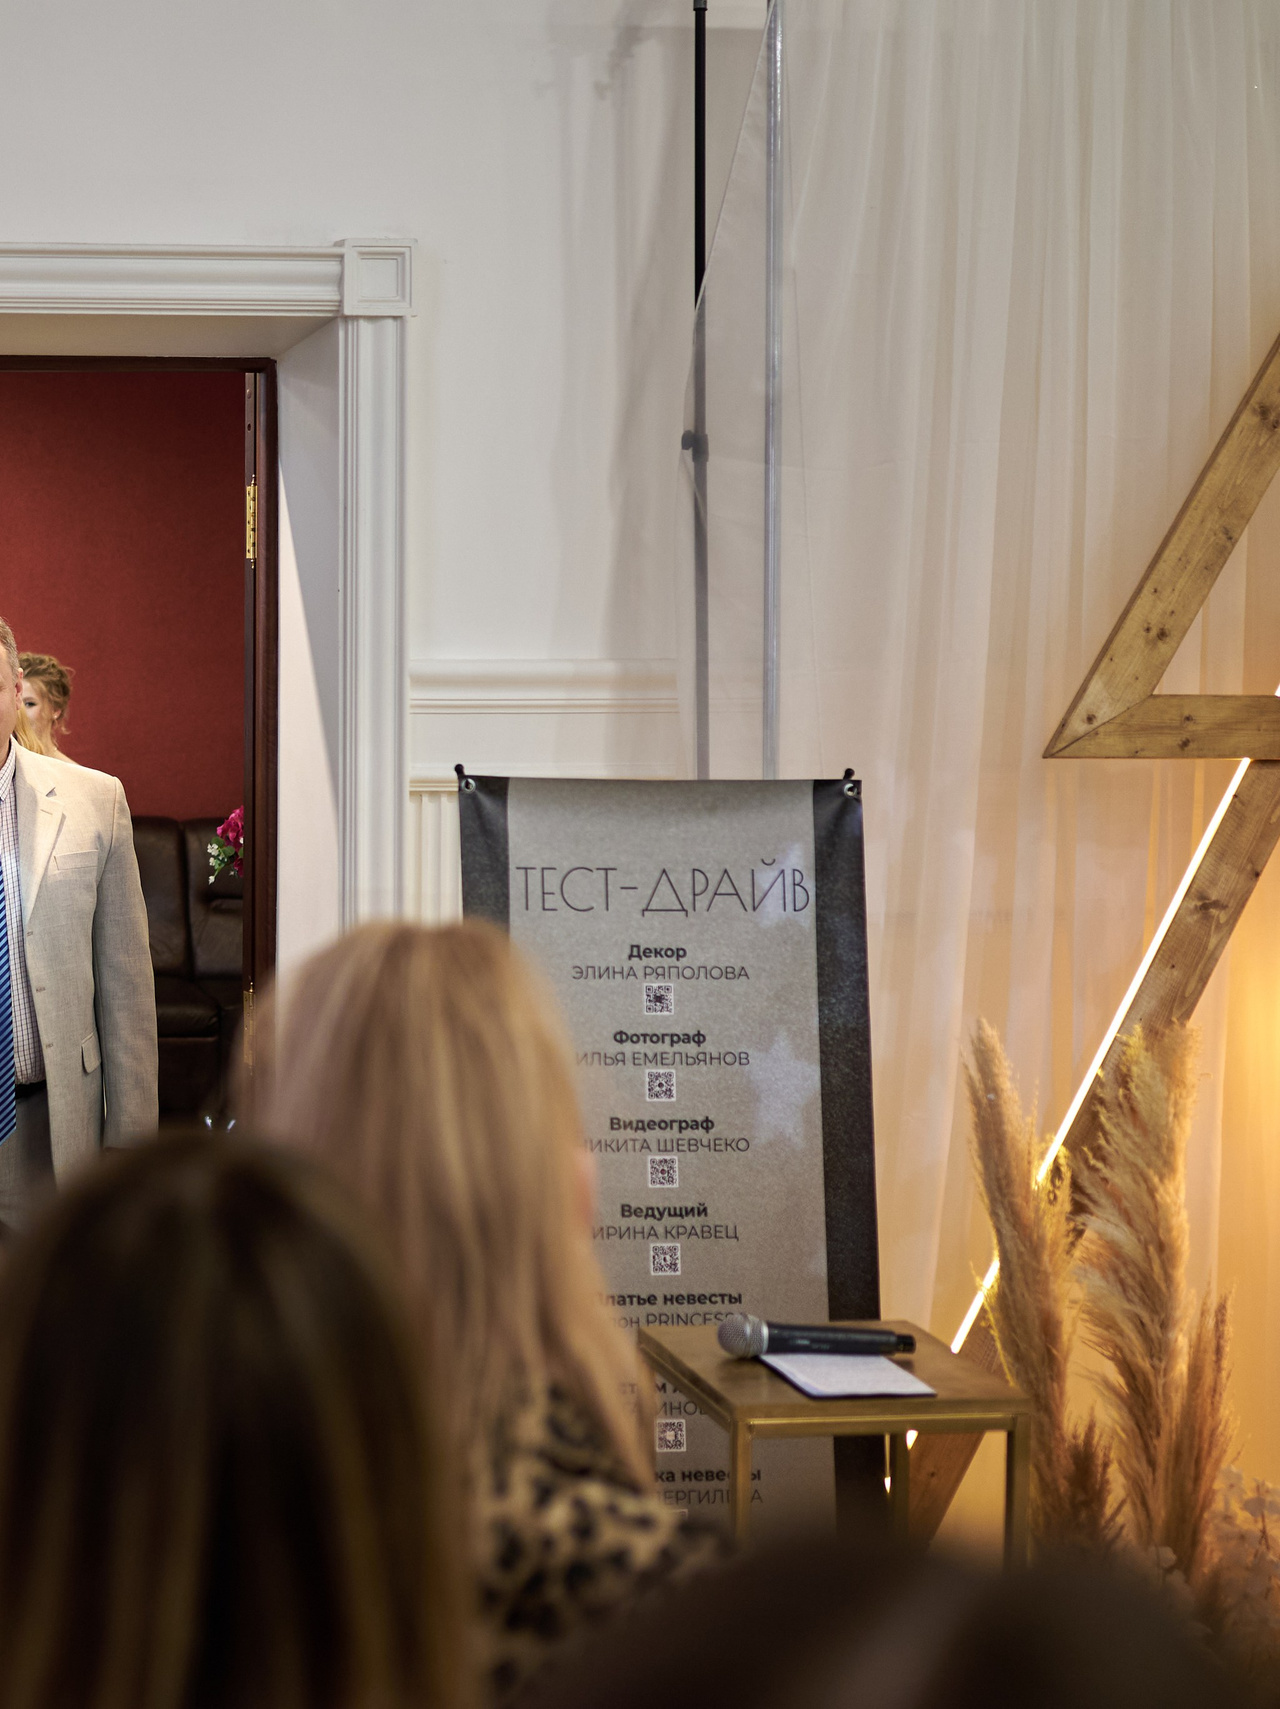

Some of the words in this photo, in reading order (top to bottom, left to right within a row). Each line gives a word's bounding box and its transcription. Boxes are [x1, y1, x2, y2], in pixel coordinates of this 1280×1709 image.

[515, 858, 811, 918] ТЕСТ-ДРАЙВ
[628, 944, 688, 961] Декор
[572, 965, 638, 980] ЭЛИНА
[643, 965, 750, 980] РЯПОЛОВА
[613, 1030, 707, 1047] Фотограф
[576, 1051, 627, 1066] ИЛЬЯ
[632, 1051, 751, 1066] ЕМЕЛЬЯНОВ
[609, 1116, 715, 1134] Видеограф
[657, 1138, 750, 1153] ШЕВЧЕКО
[621, 1203, 708, 1221] Ведущий
[592, 1225, 659, 1241] ИРИНА
[665, 1225, 740, 1242] КРАВЕЦ
[600, 1293, 658, 1307] латье
[663, 1293, 743, 1306] невесты
